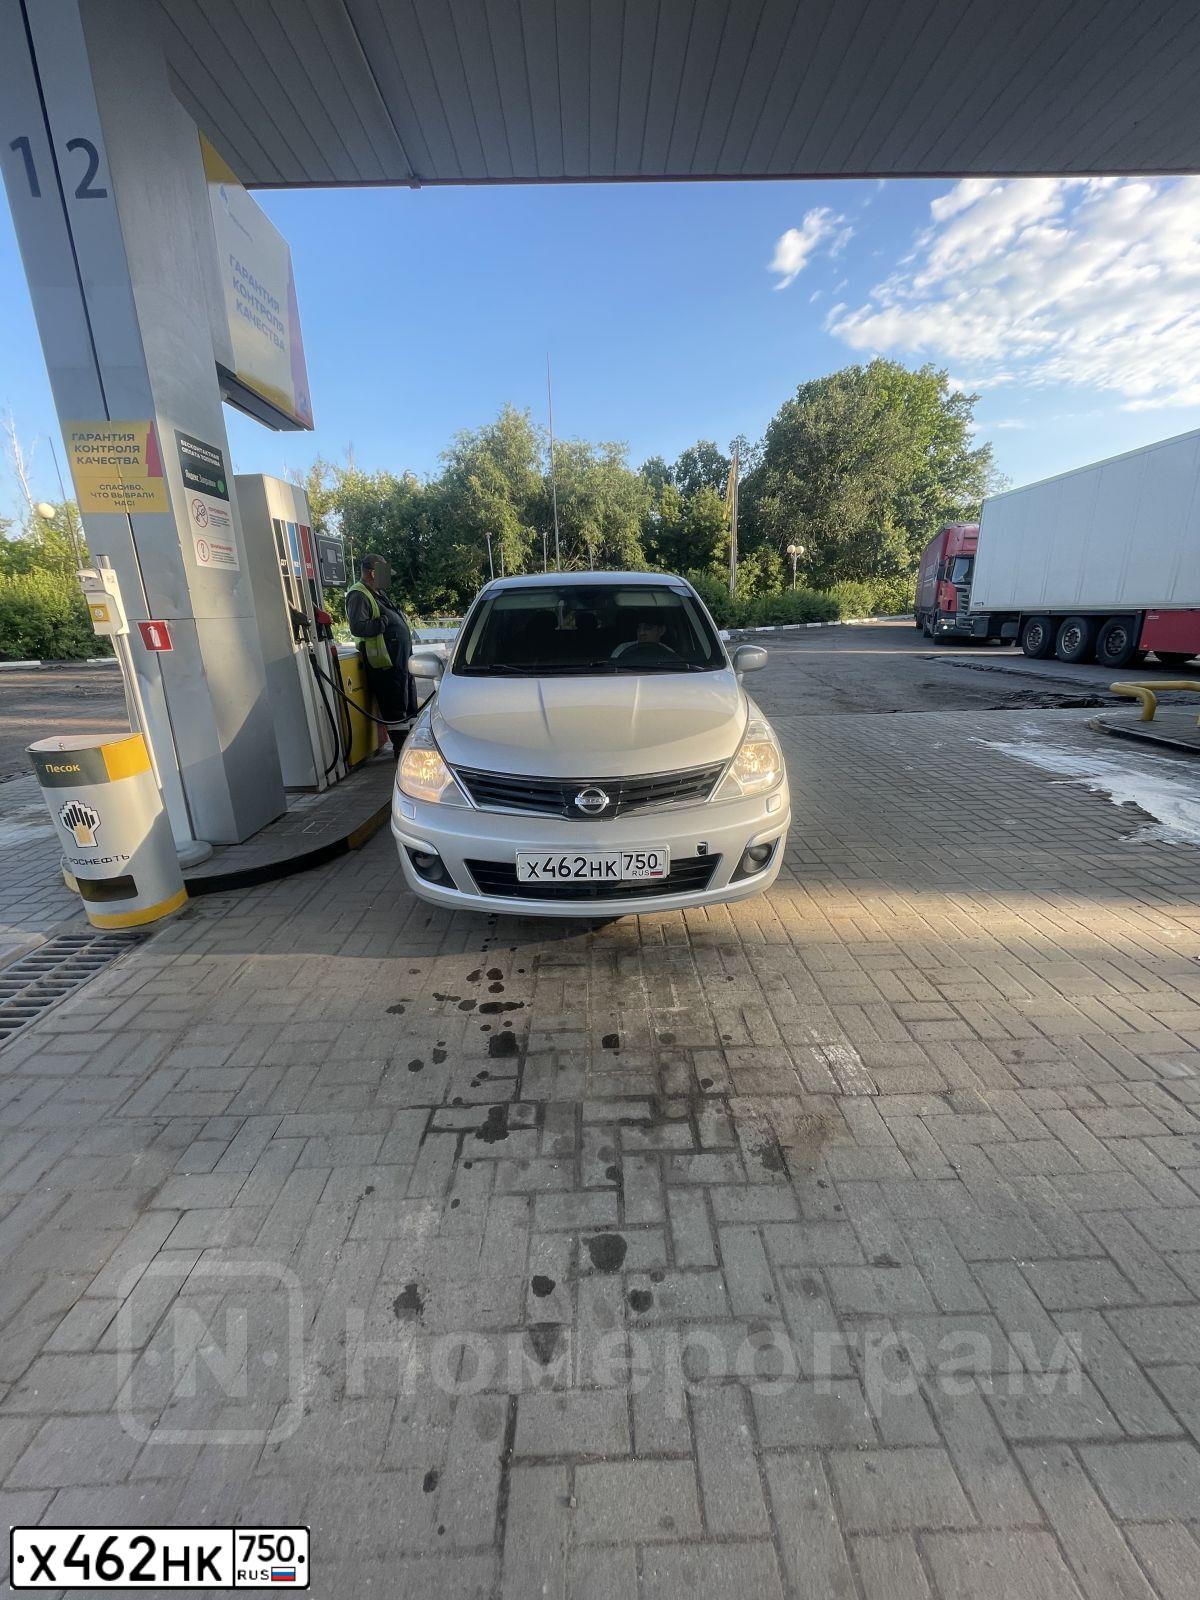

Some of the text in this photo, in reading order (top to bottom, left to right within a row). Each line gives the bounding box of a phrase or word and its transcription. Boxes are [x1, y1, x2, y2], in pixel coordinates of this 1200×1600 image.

[229, 254, 280, 314] ГАРАНТИЯ
[232, 276, 285, 335] КОНТРОЛЯ
[236, 298, 286, 352] КАЧЕСТВА
[72, 433, 135, 442] ГАРАНТИЯ
[74, 445, 141, 454] КОНТРОЛЯ
[77, 456, 140, 465] КАЧЕСТВА
[45, 764, 81, 773] Песок
[527, 853, 658, 878] Х462НК 750
